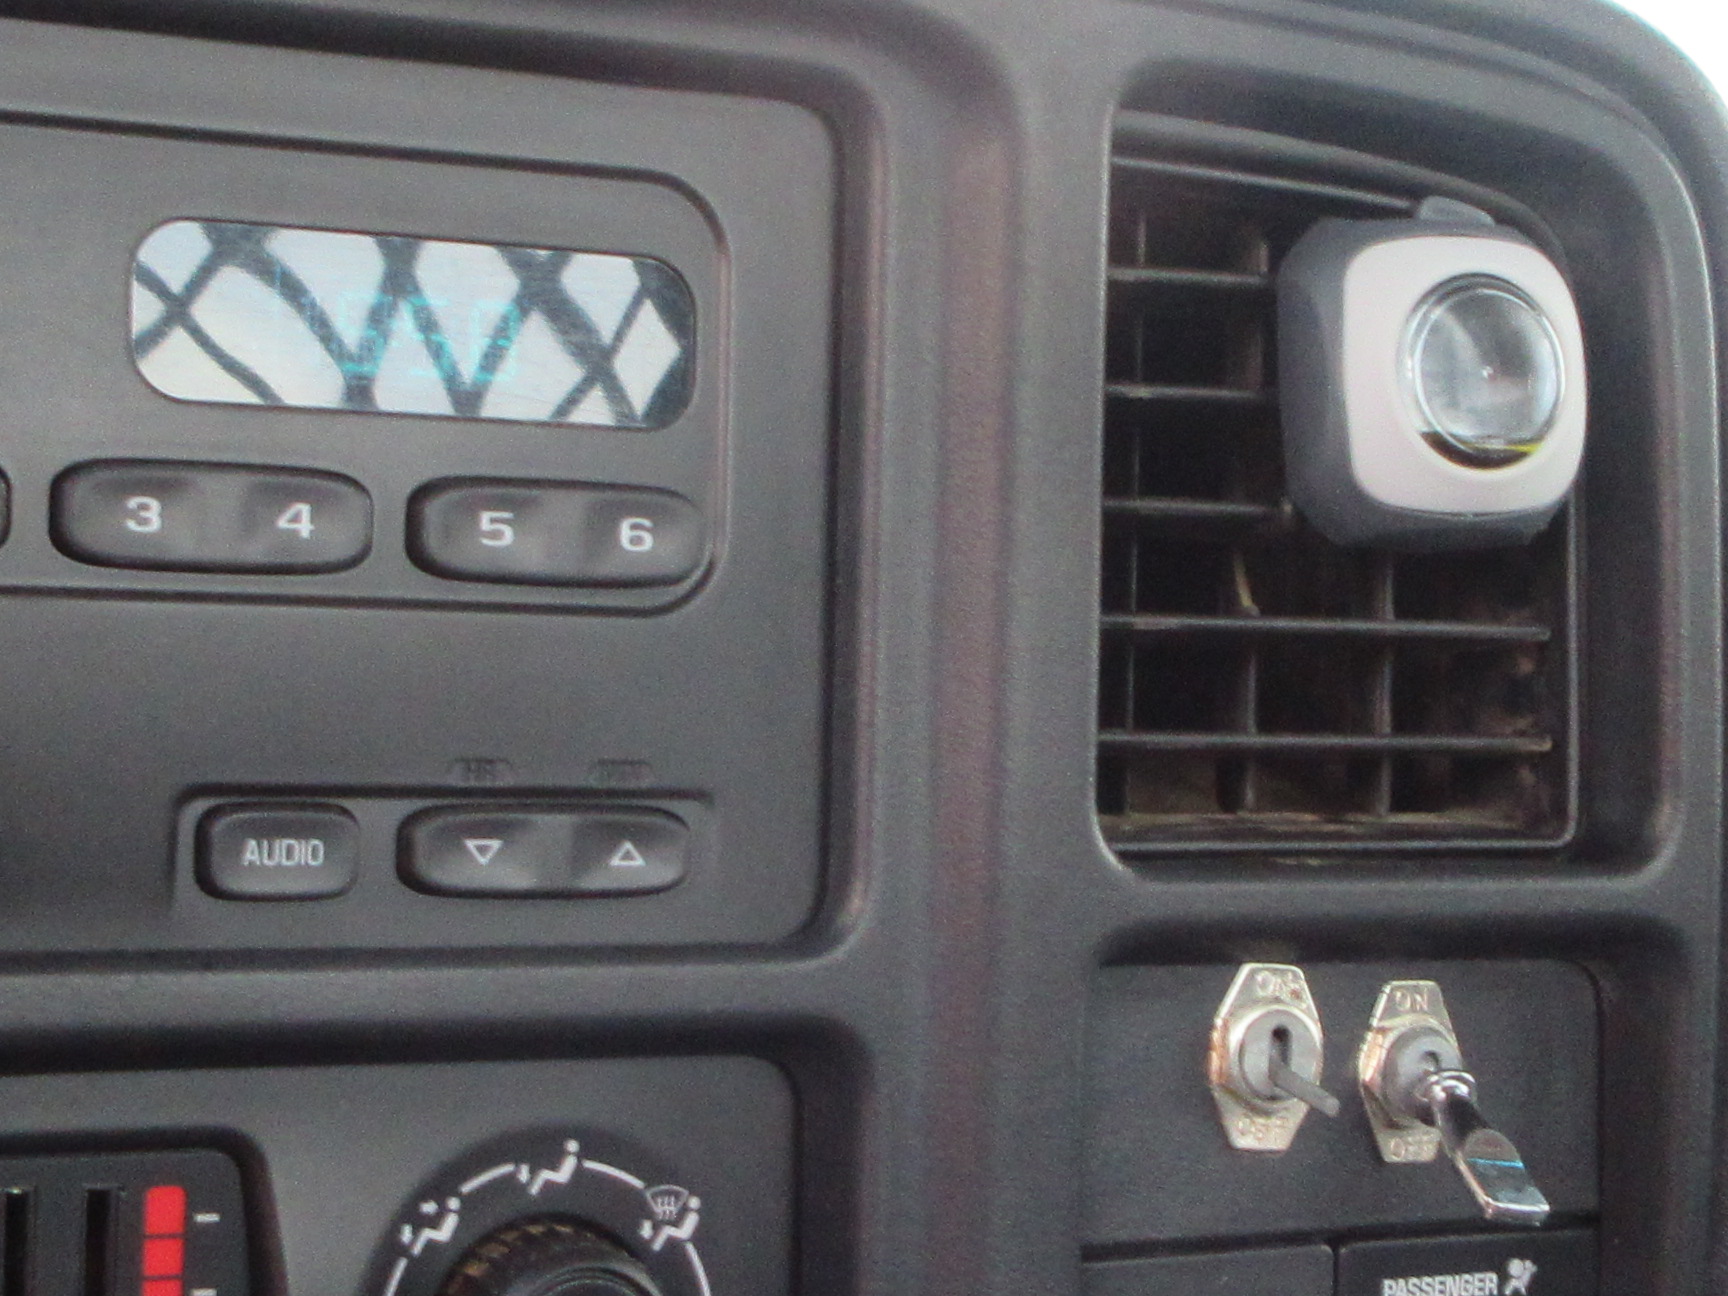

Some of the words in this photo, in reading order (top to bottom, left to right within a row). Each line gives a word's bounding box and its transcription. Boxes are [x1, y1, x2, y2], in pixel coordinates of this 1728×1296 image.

[125, 496, 163, 534] 3
[275, 502, 316, 540] 4
[479, 510, 515, 548] 5
[618, 517, 655, 553] 6
[242, 838, 325, 868] AUDIO
